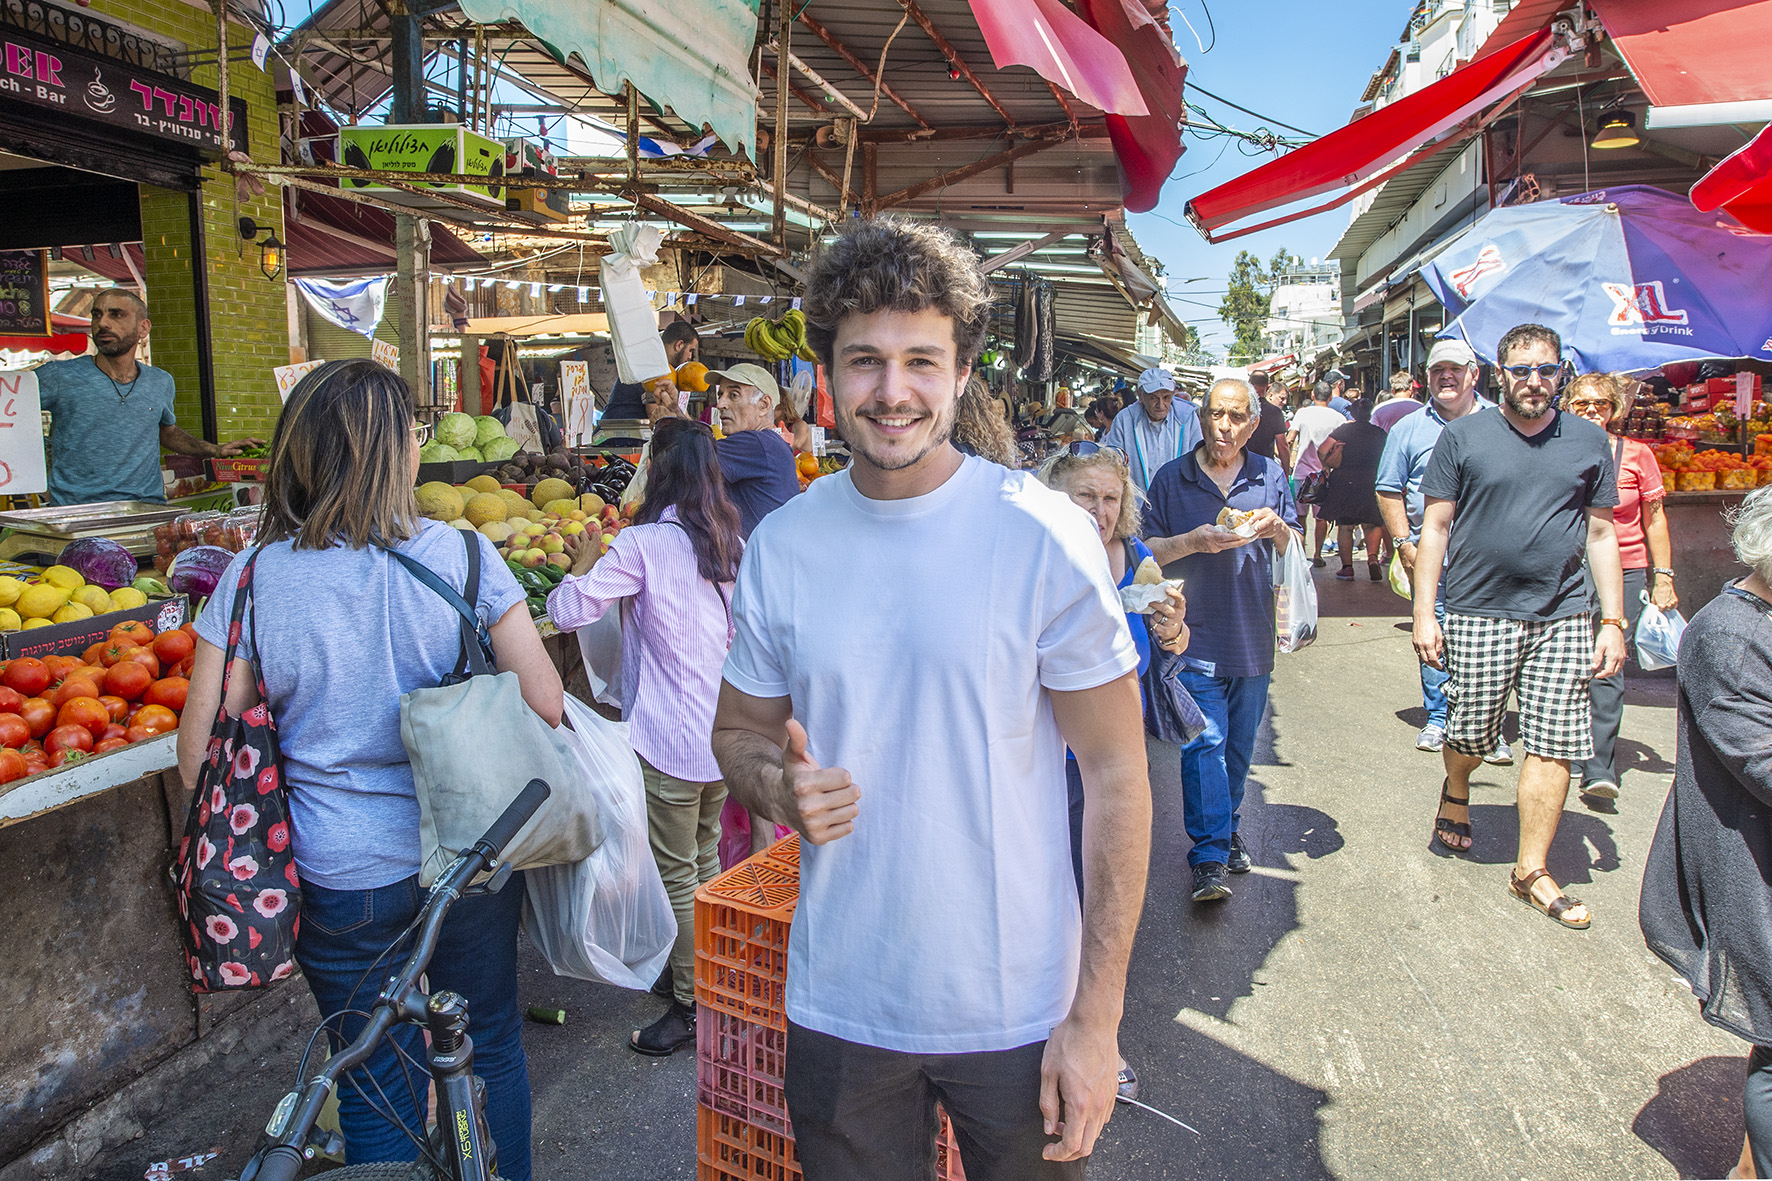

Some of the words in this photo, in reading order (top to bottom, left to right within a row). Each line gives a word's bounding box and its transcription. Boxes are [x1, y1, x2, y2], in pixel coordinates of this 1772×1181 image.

[0, 42, 66, 88] ER
[36, 85, 66, 104] Bar
[213, 134, 236, 150] קה
[1601, 280, 1689, 325] XL
